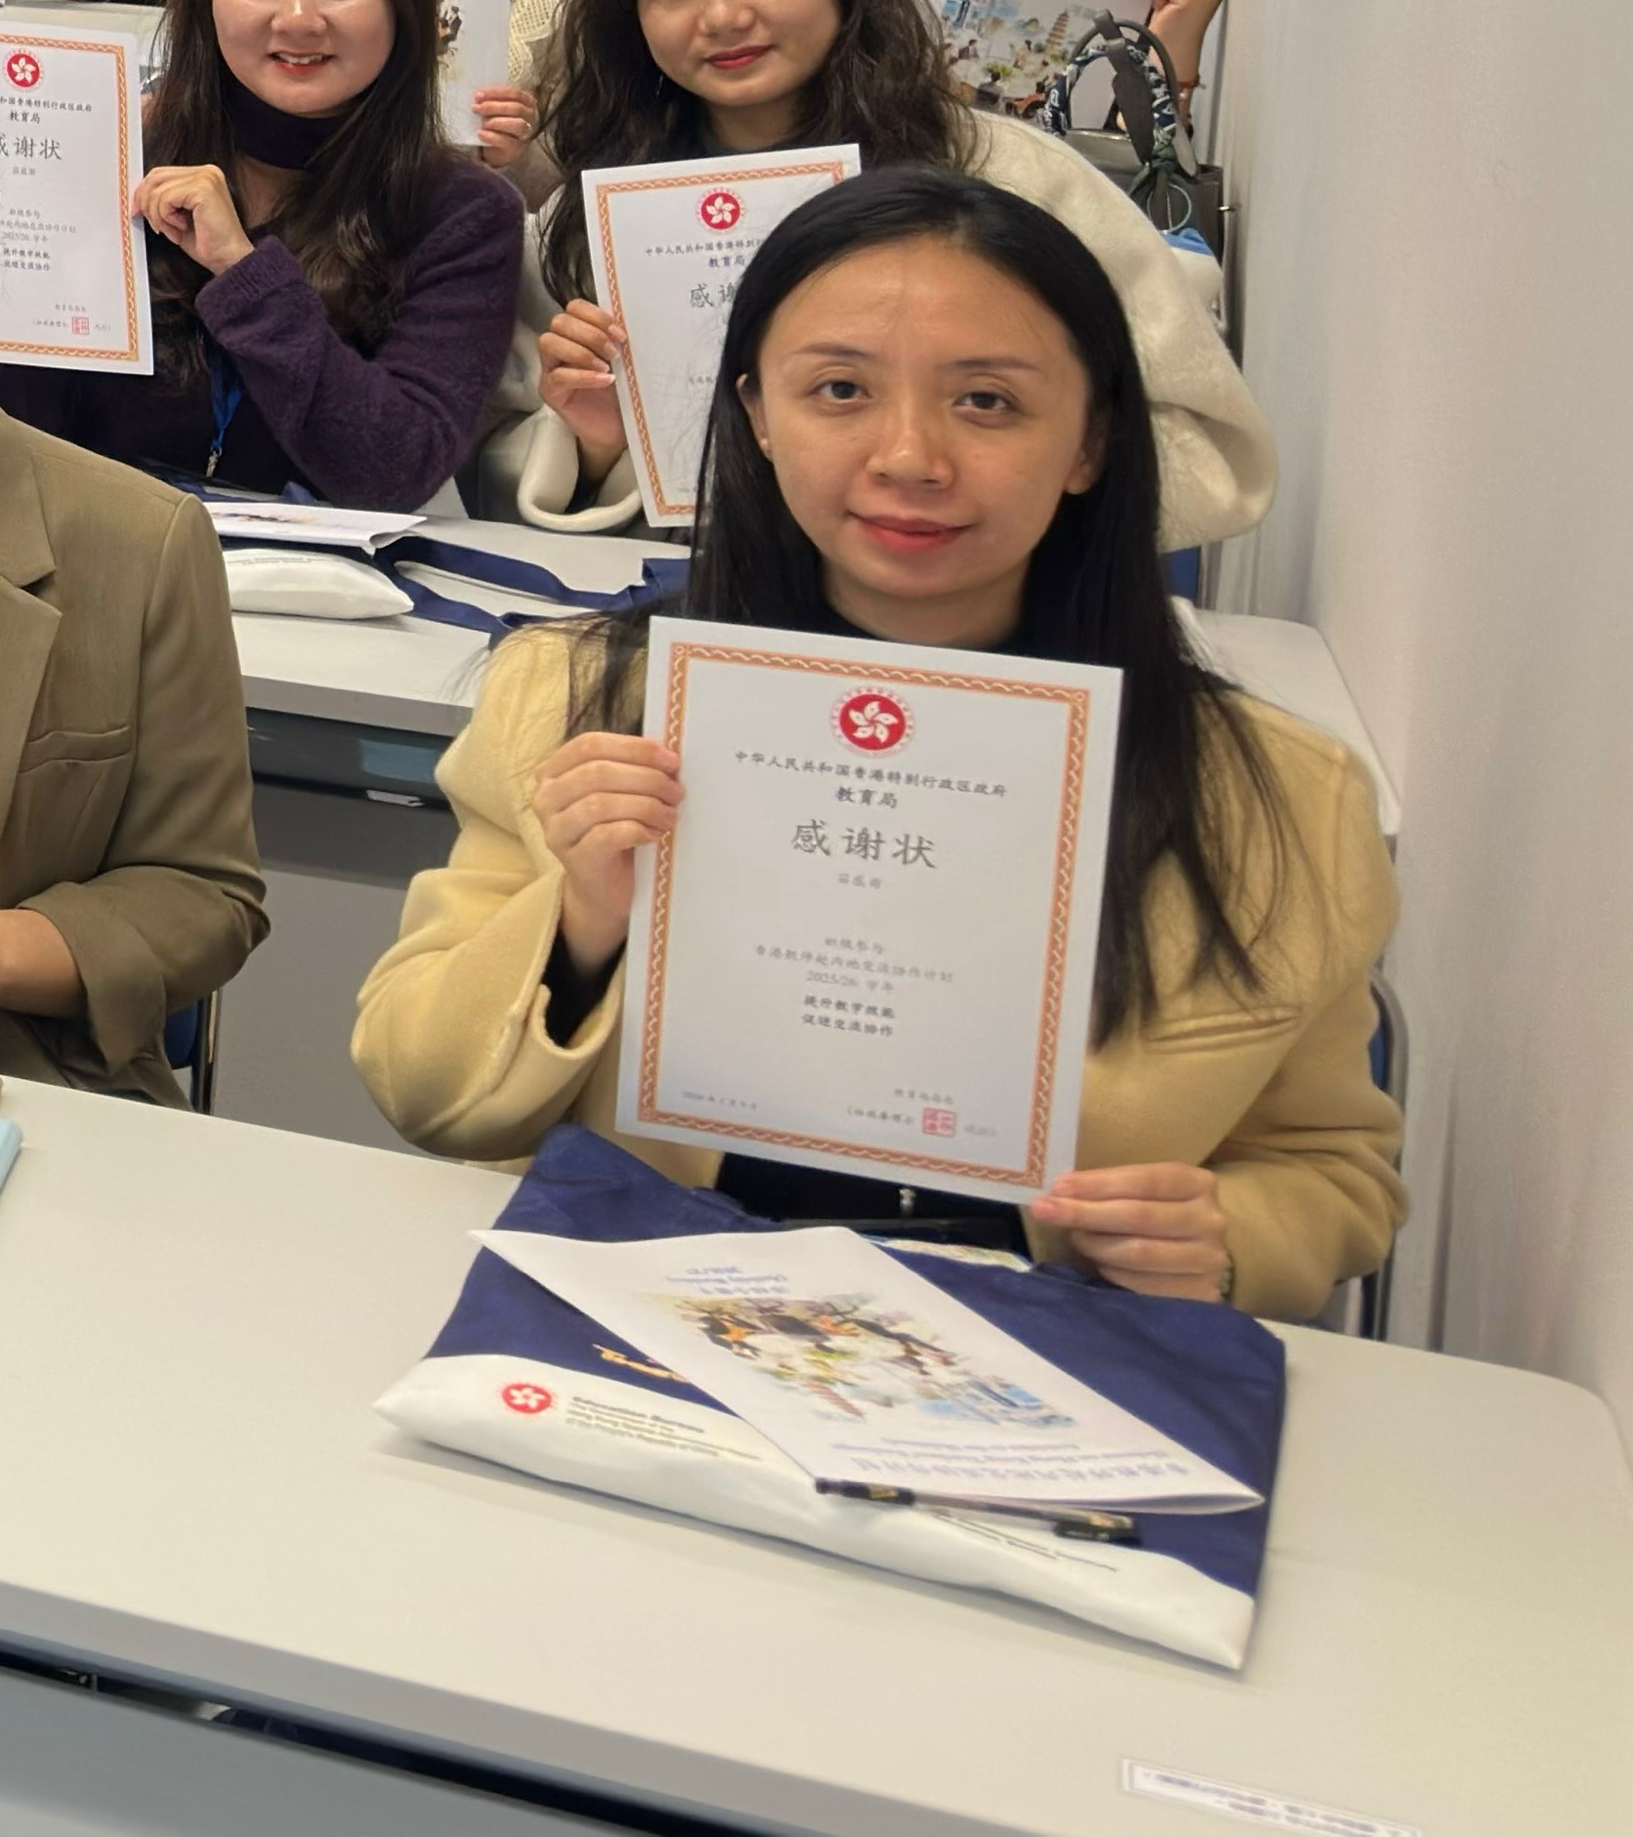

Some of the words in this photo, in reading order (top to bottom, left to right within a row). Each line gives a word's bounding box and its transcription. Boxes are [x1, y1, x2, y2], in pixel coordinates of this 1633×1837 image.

[9, 111, 41, 124] 教育局
[645, 239, 763, 256] 中华人民共和国香港特别
[708, 256, 745, 269] 教育局
[734, 750, 1009, 799] 中华人民共和国香港特别行政区政府
[835, 787, 899, 810] 教育局
[791, 818, 937, 870] 感谢状
